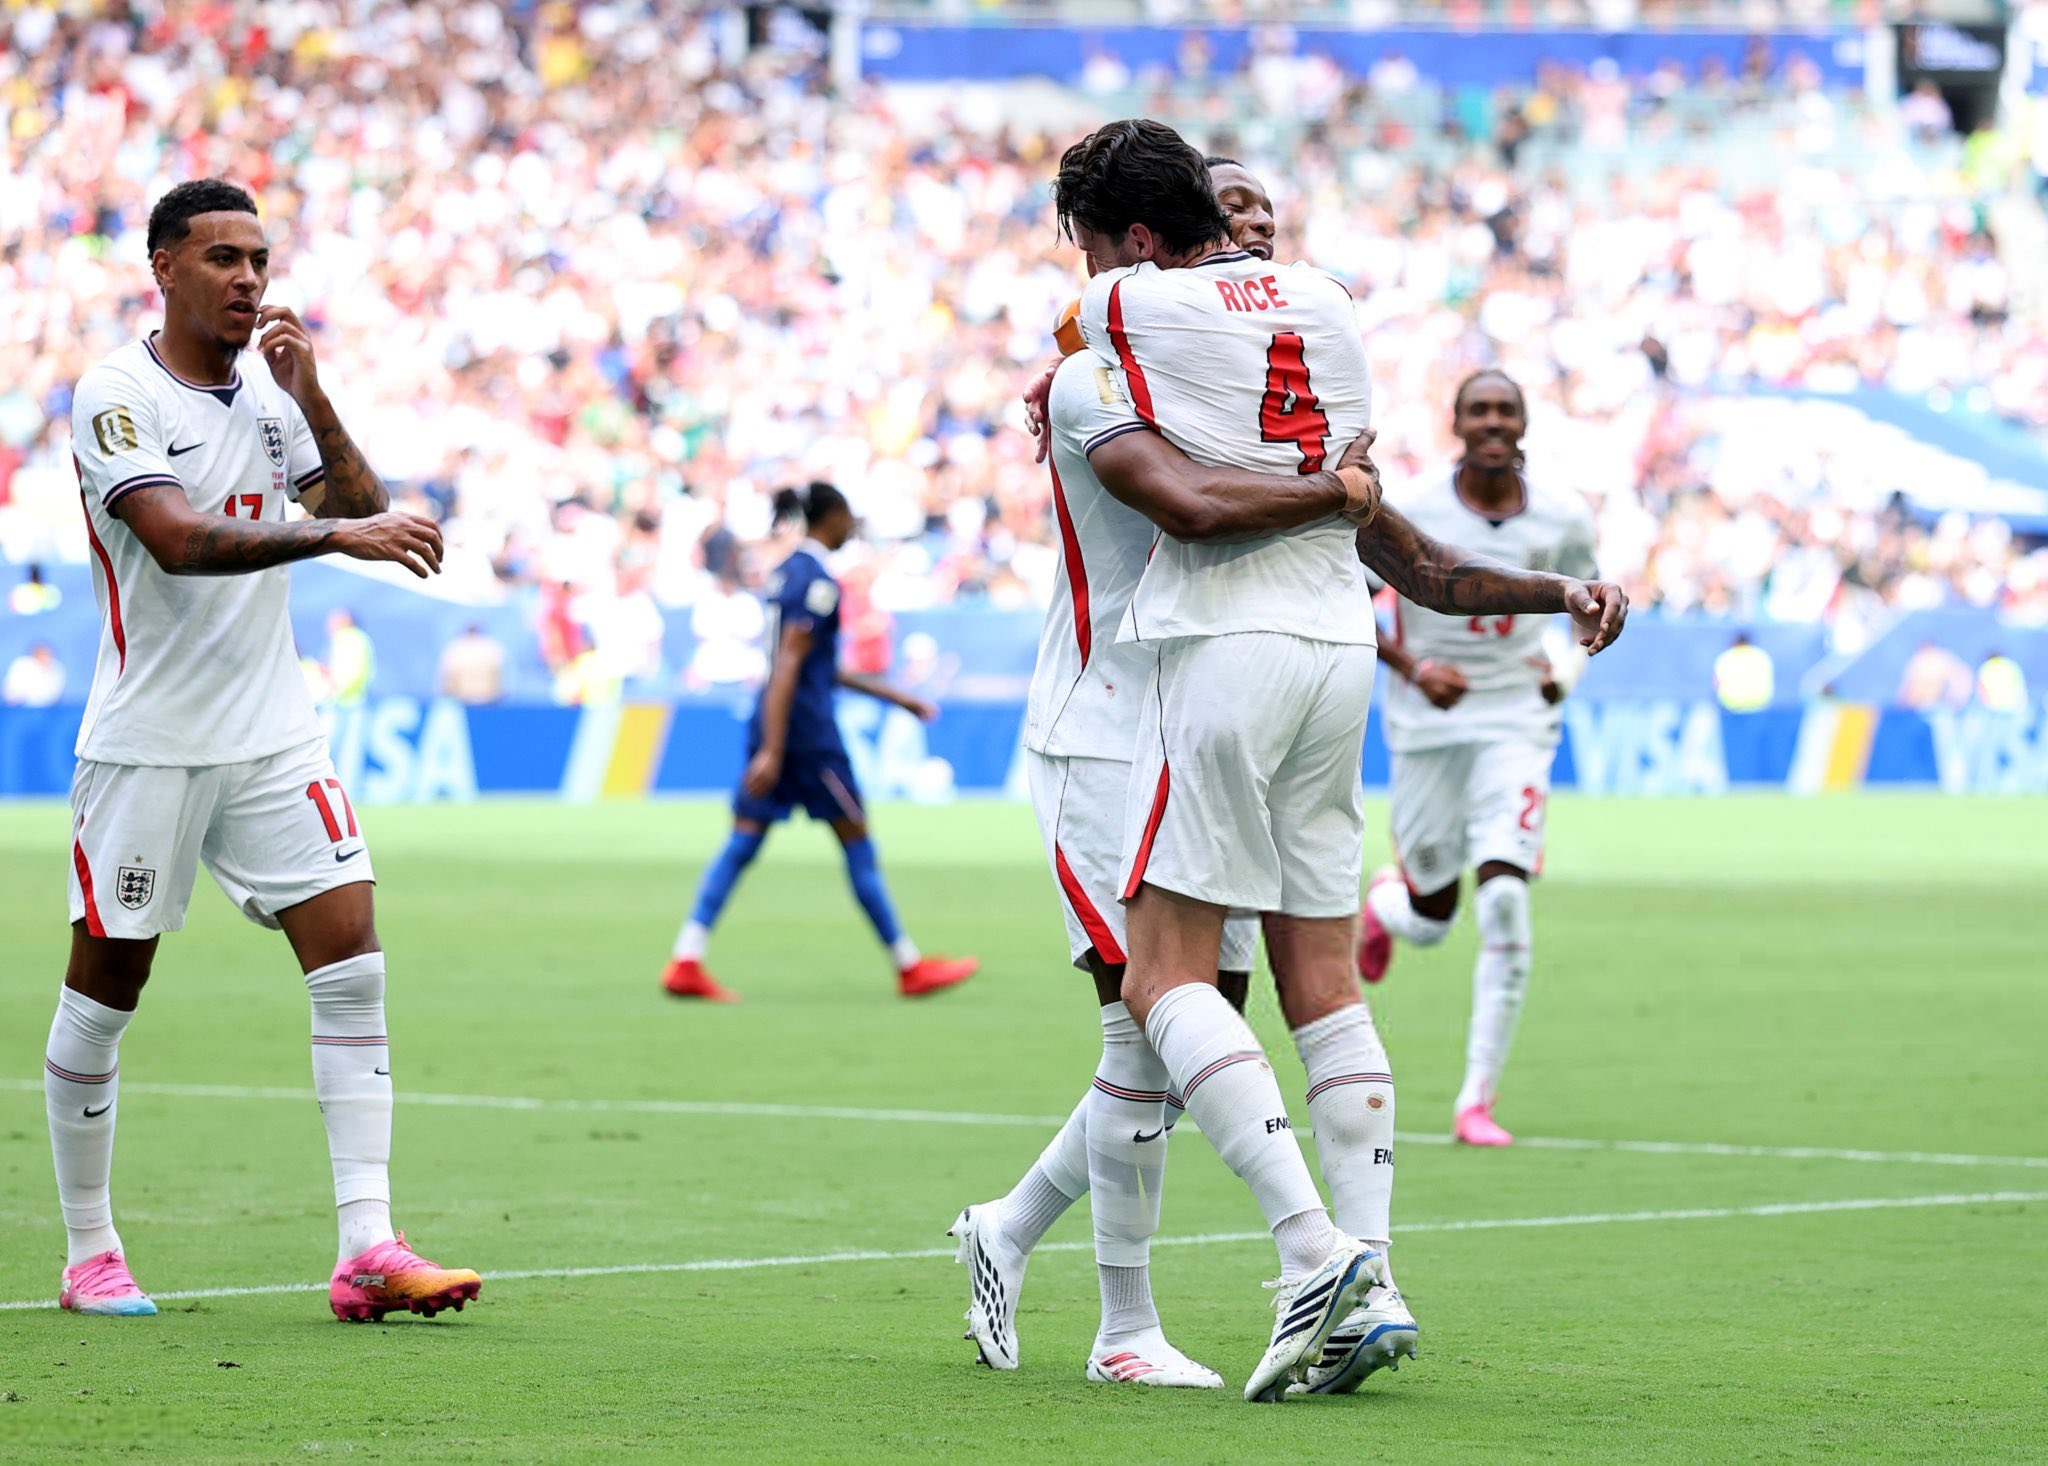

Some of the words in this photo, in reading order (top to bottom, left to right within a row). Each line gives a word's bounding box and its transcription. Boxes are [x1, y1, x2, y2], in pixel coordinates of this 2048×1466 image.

[1215, 275, 1288, 312] RICE
[1258, 331, 1332, 475] 4
[834, 694, 942, 803] SA
[1568, 702, 1729, 794] VISA
[1926, 704, 2048, 795] VIS
[306, 778, 358, 843] 17
